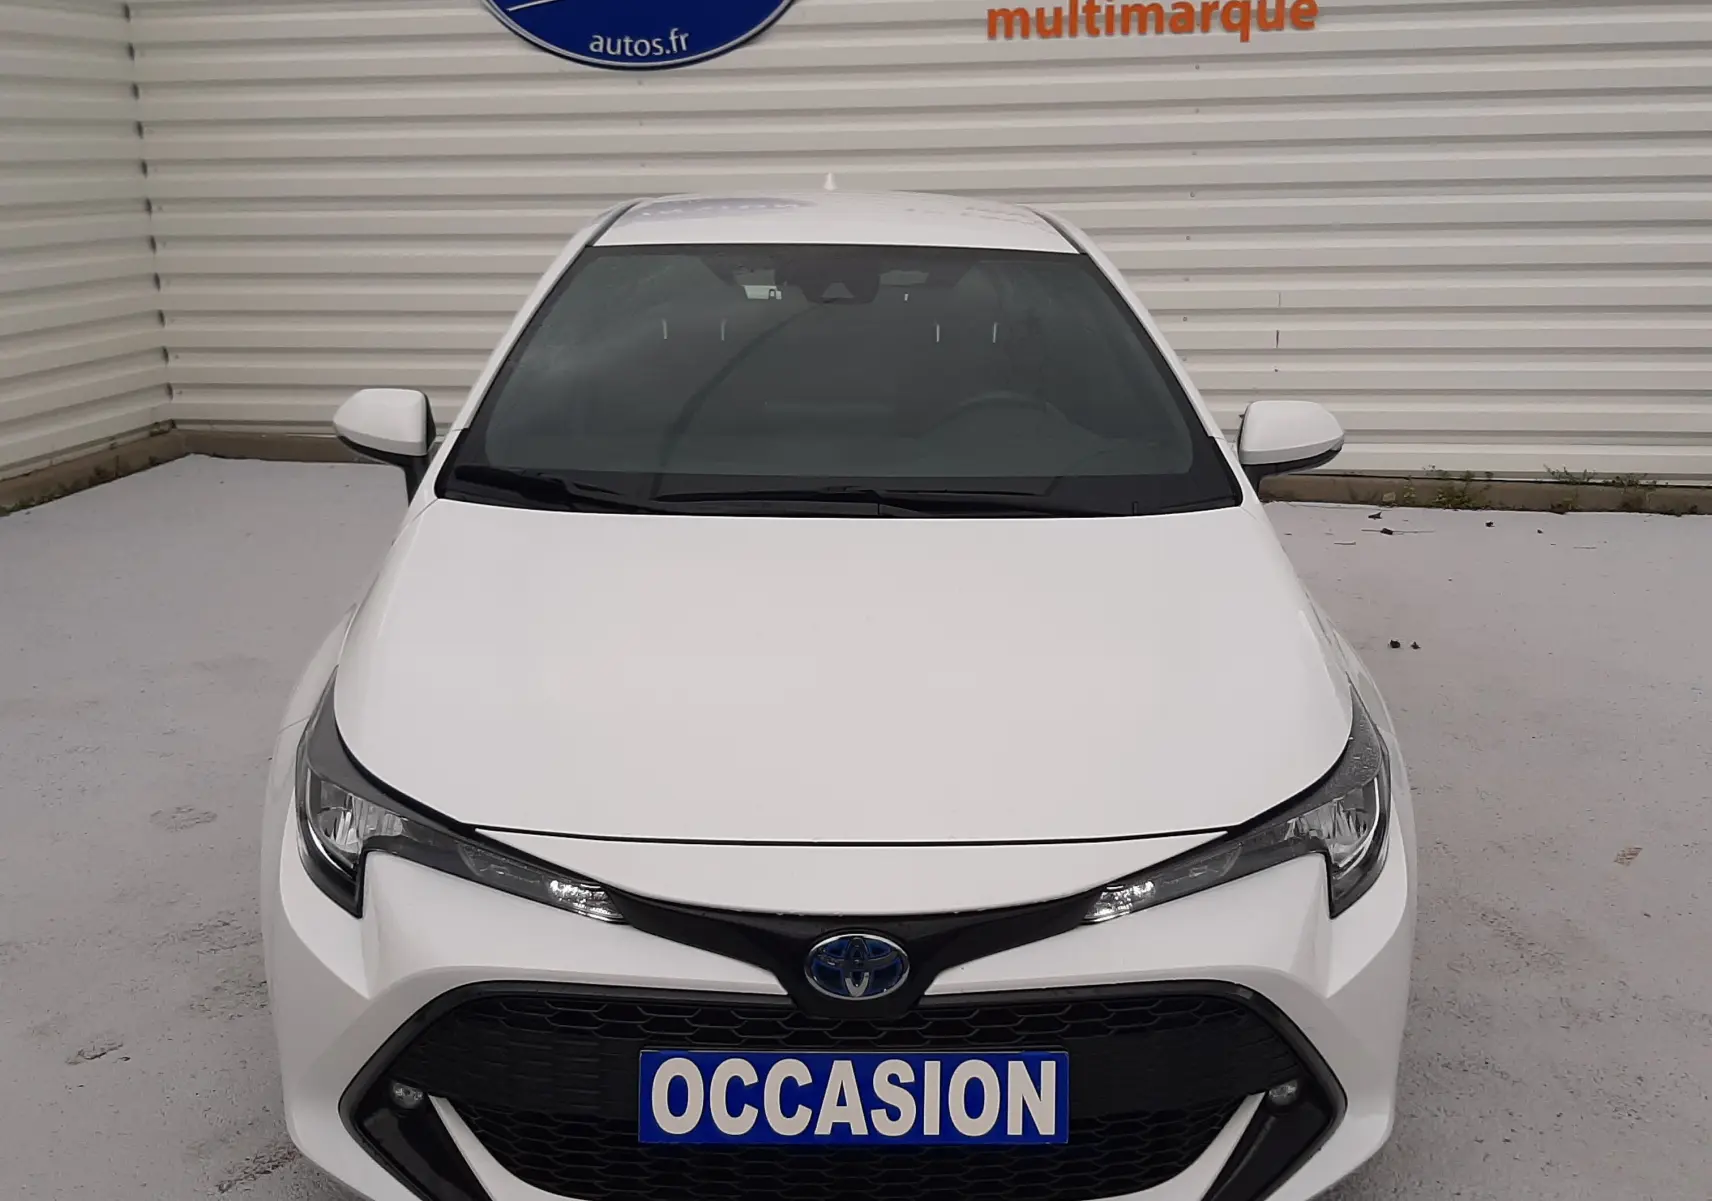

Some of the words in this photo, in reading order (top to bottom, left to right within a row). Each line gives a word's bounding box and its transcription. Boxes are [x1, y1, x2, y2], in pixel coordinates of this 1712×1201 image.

[987, 0, 1319, 42] multimarque
[589, 28, 690, 57] autos.fr
[651, 1057, 1056, 1136] OCCASION
